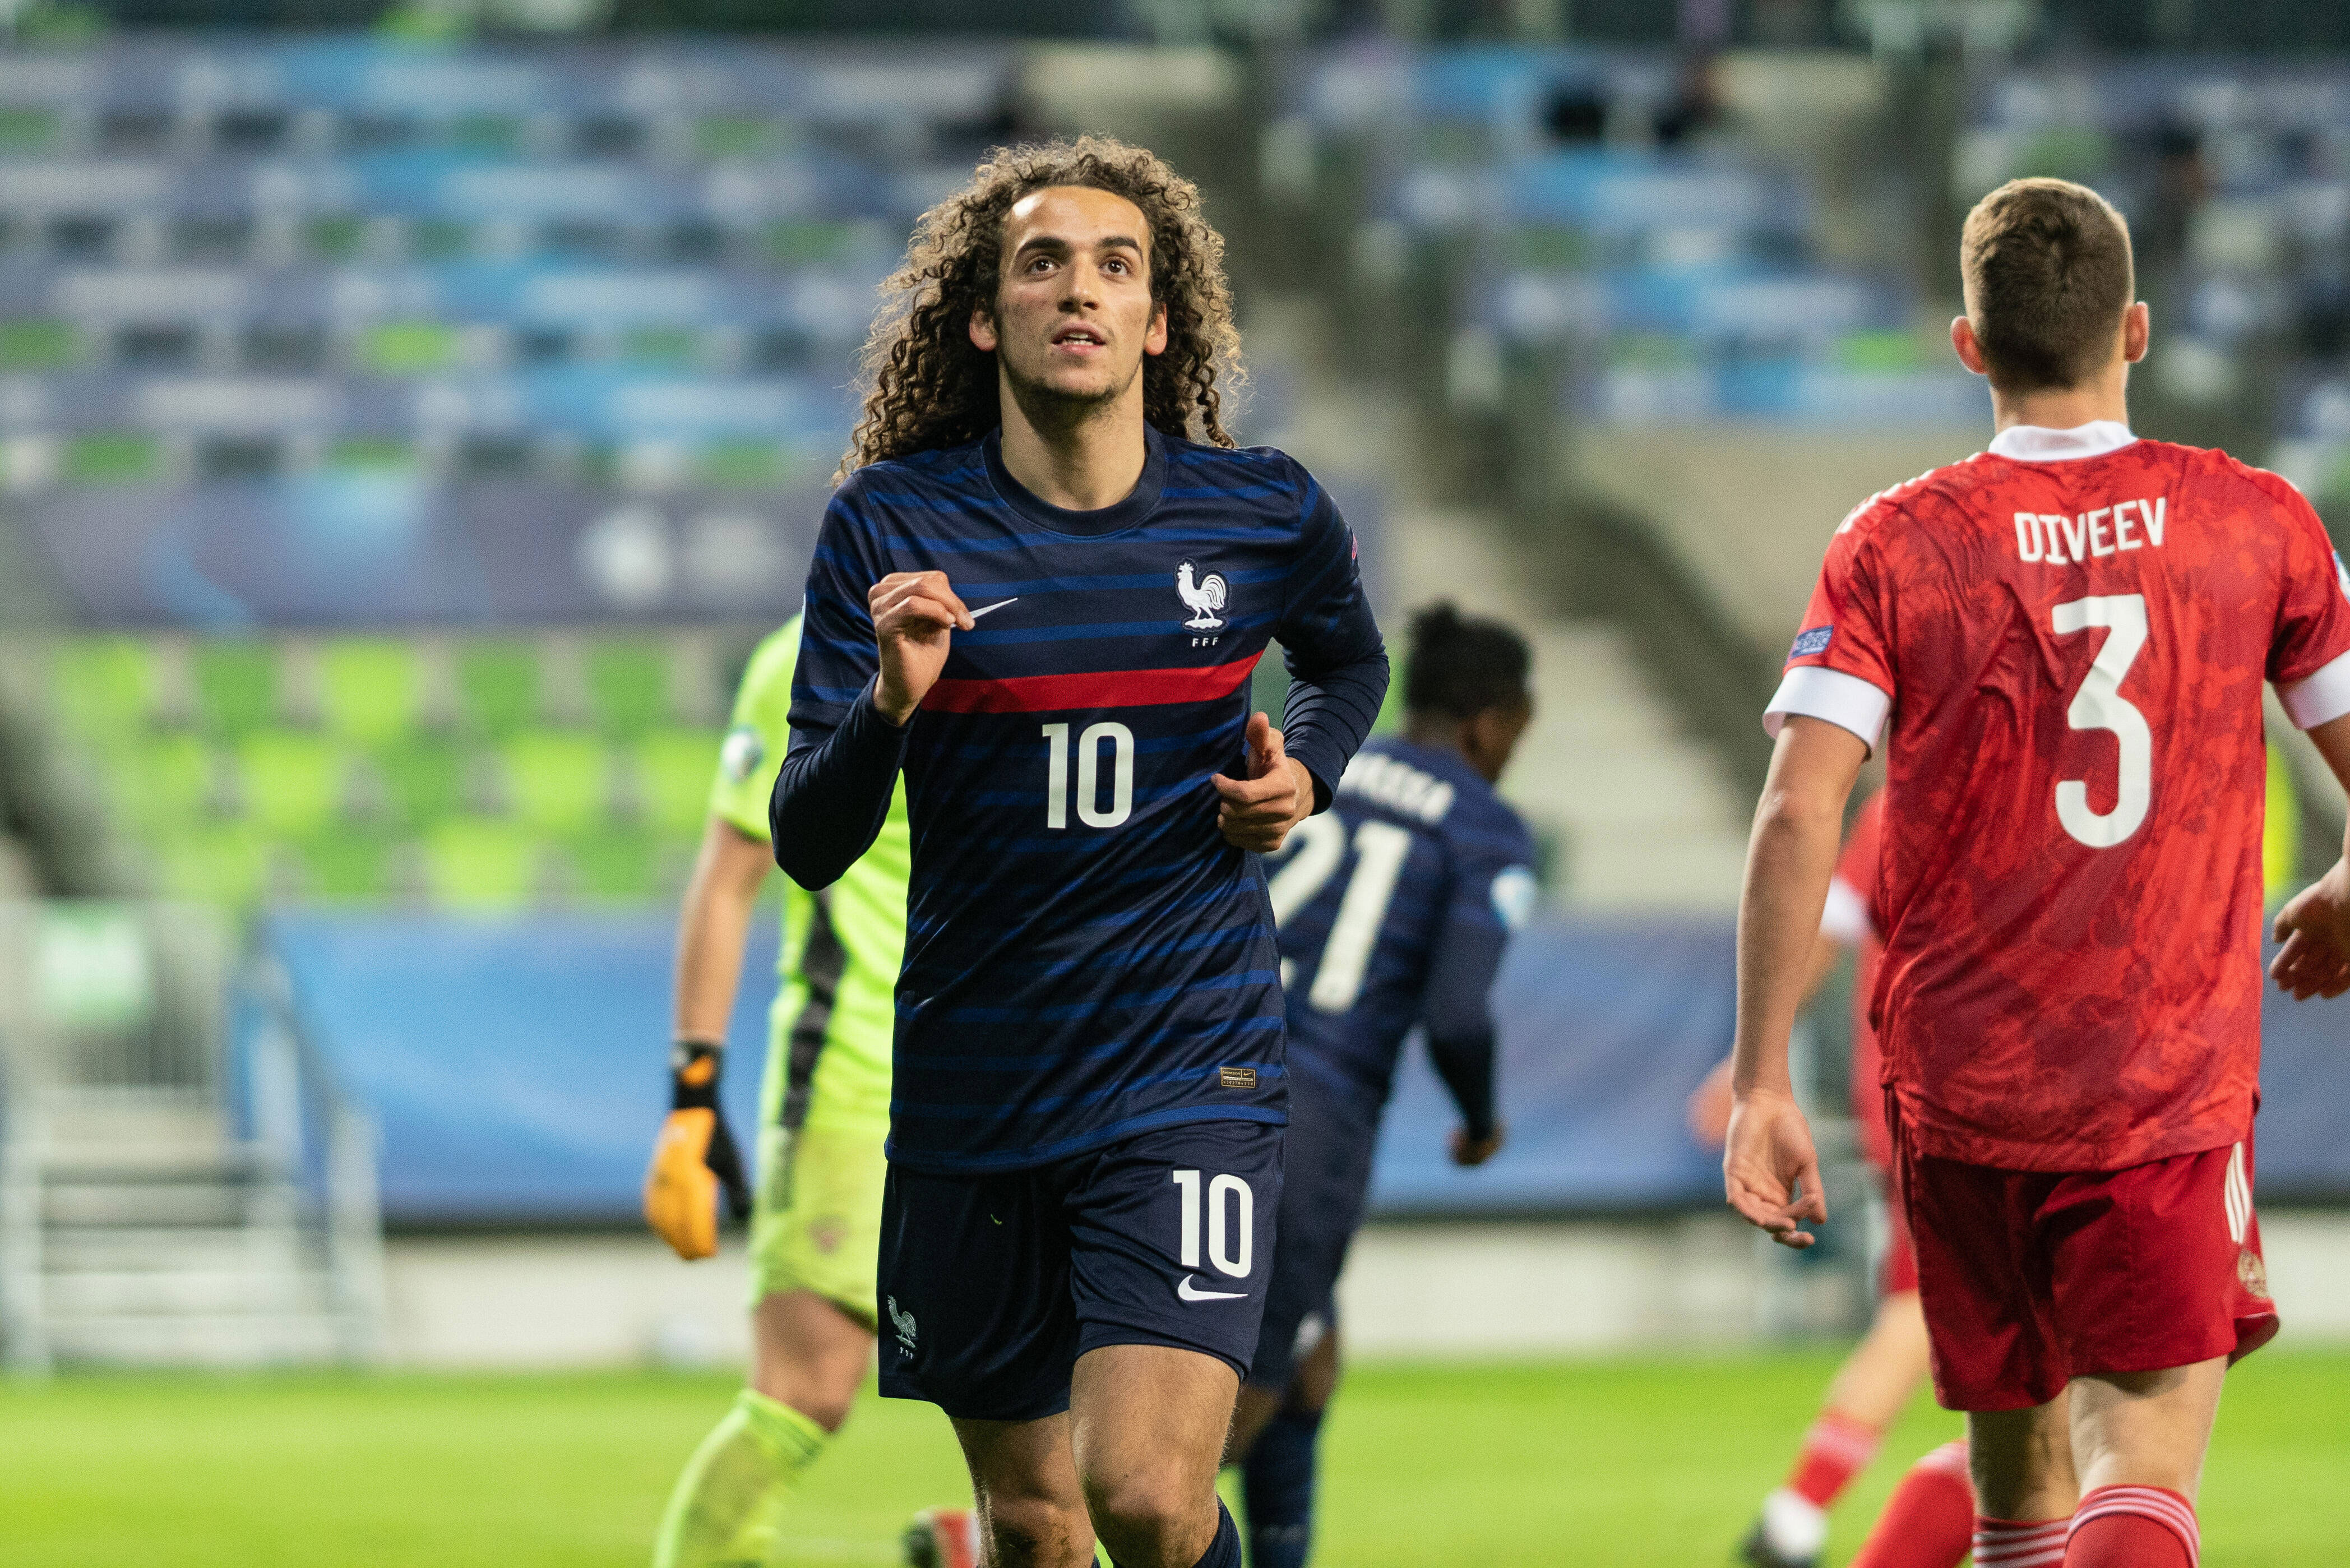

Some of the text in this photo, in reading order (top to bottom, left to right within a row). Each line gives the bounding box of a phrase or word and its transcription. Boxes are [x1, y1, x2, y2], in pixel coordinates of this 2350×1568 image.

[2014, 497, 2167, 566] DIVEEV
[1042, 722, 1134, 829] 10
[2052, 594, 2152, 848] 3
[1260, 807, 1412, 1012] 21
[1173, 1169, 1253, 1278] 10
